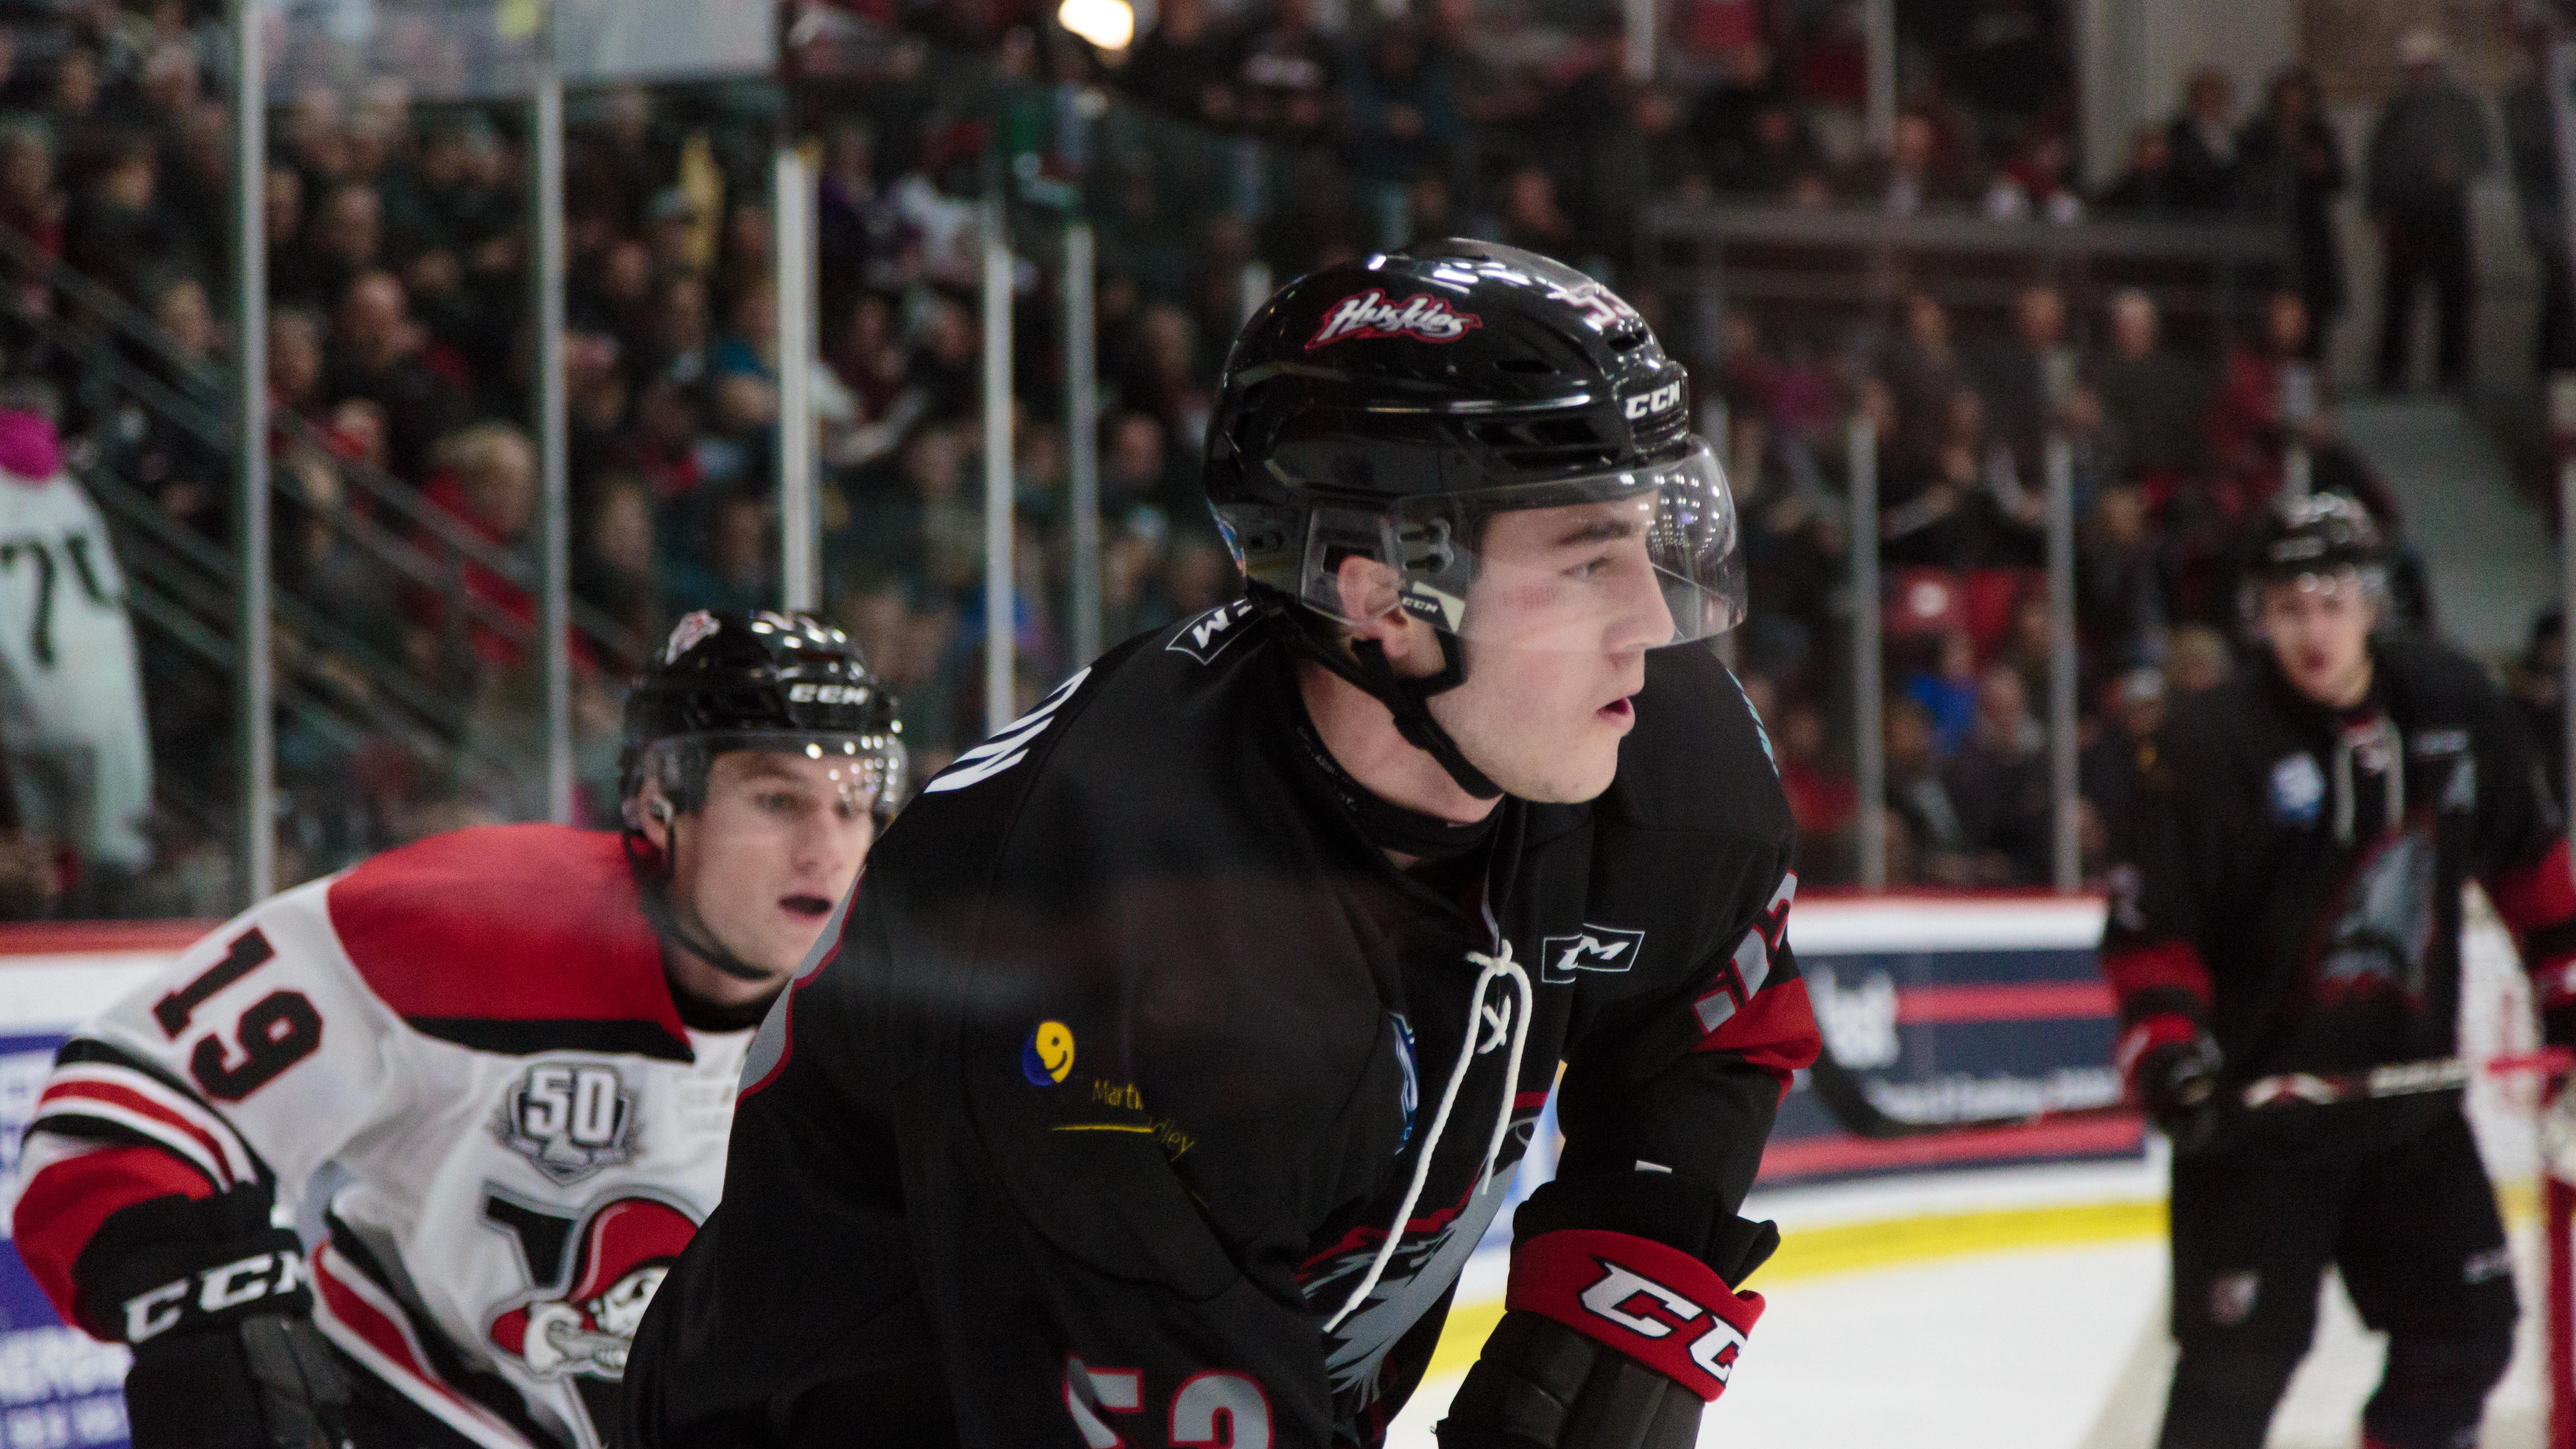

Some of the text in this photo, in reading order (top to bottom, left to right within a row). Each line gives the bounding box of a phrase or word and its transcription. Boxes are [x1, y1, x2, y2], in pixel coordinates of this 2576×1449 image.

[1314, 291, 1475, 341] Huskies
[1625, 380, 1681, 419] CCM
[1402, 596, 1439, 614] CCM
[789, 683, 869, 705] CCM
[153, 925, 322, 1101] 19
[525, 1068, 619, 1145] 50
